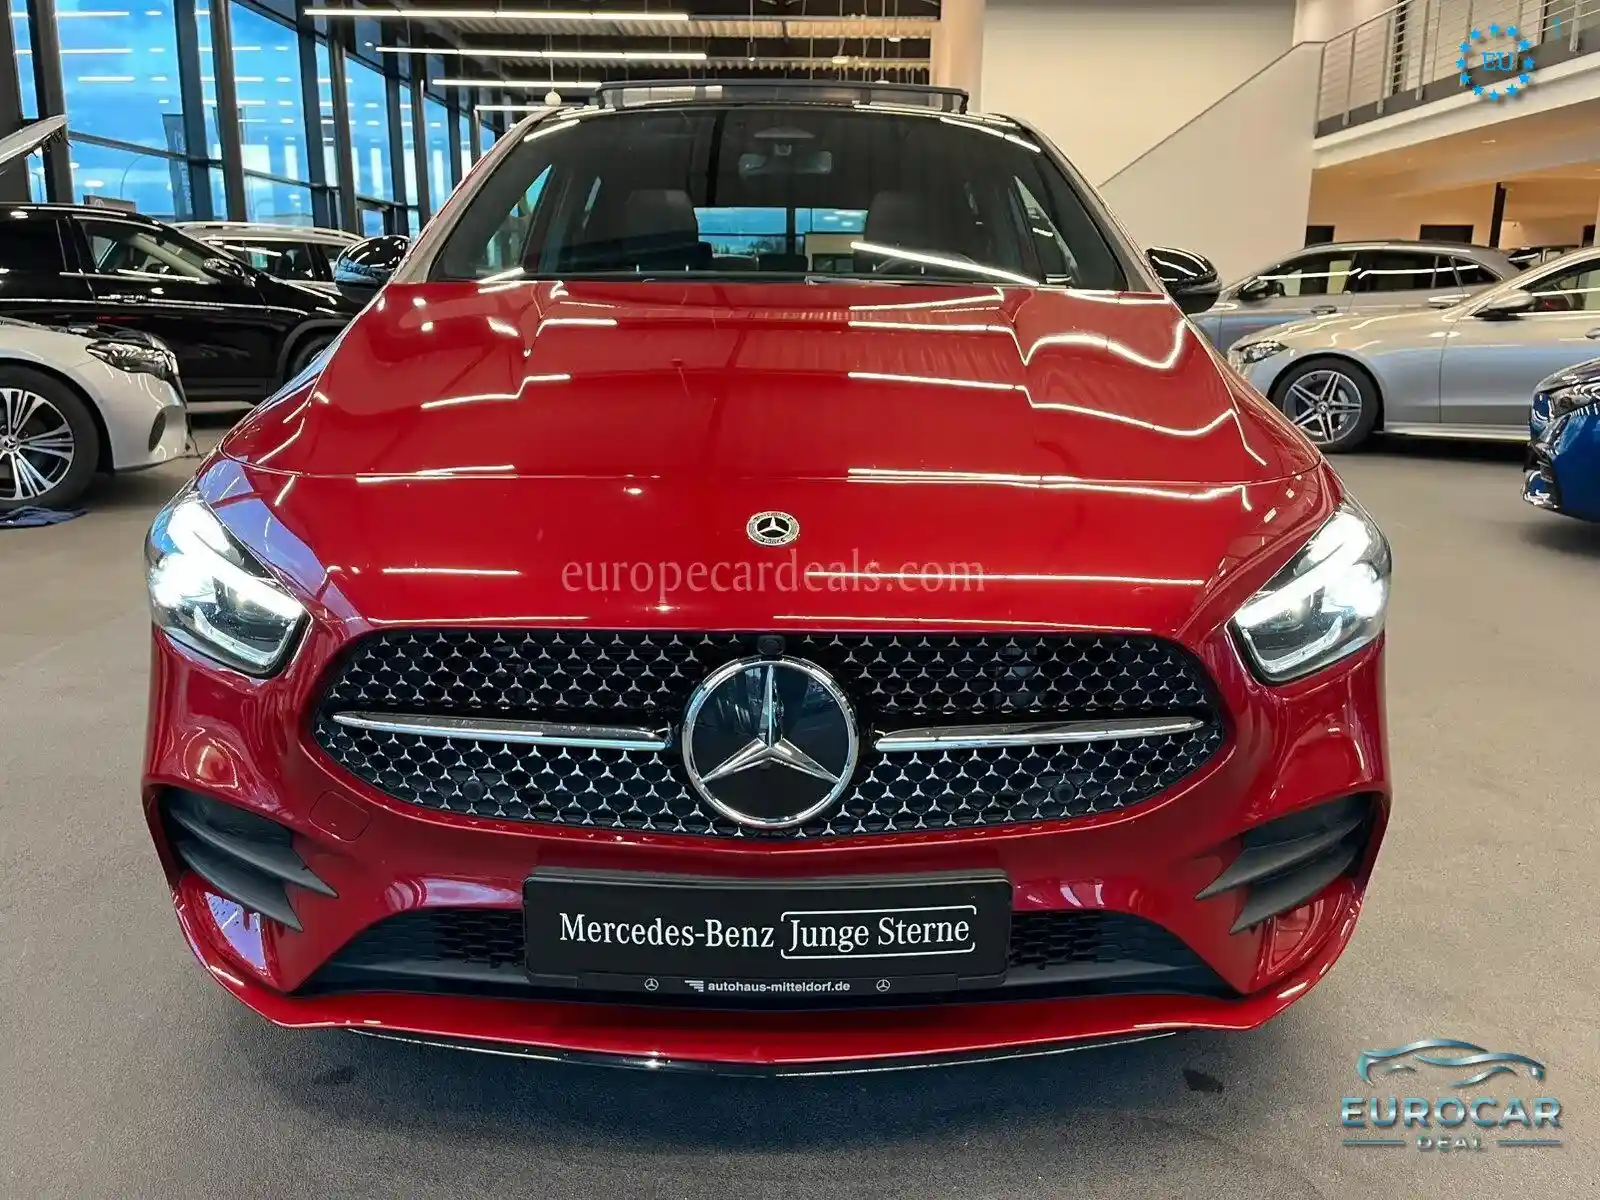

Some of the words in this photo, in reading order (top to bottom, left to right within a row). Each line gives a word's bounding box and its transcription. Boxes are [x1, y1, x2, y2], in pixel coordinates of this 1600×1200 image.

[559, 912, 775, 948] Mercedes-Benz
[788, 919, 869, 952] Junge
[877, 916, 969, 946] Sterne
[707, 980, 851, 993] autohaus-mitteldorf.de
